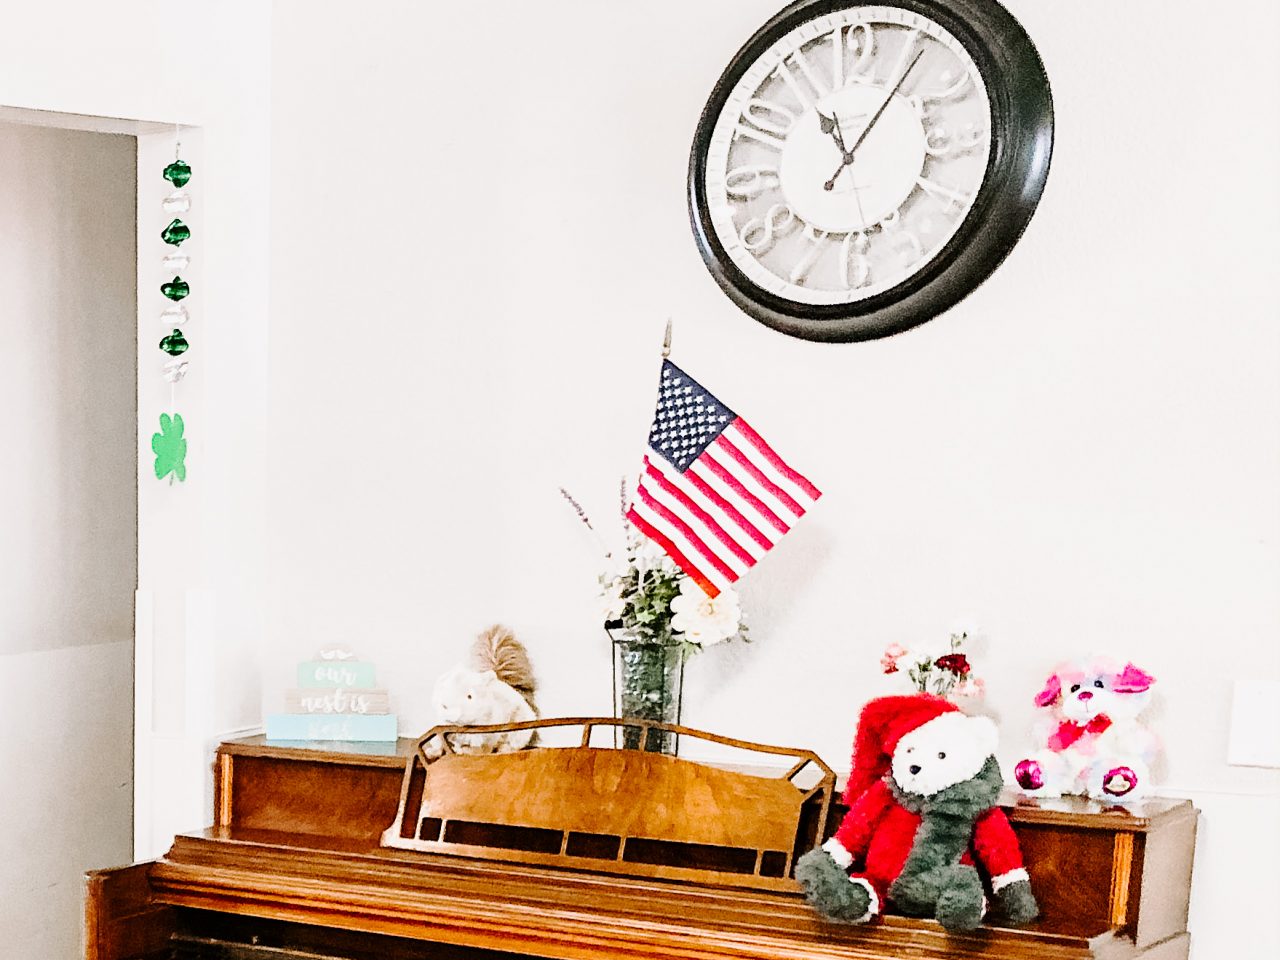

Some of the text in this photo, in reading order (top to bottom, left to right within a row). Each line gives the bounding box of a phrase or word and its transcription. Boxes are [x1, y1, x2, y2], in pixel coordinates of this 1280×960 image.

[823, 23, 877, 88] 12
[770, 49, 829, 110] 11
[733, 98, 797, 149] 10
[725, 165, 781, 195] 9
[740, 203, 793, 249] 8
[314, 666, 357, 686] our
[350, 694, 370, 714] is
